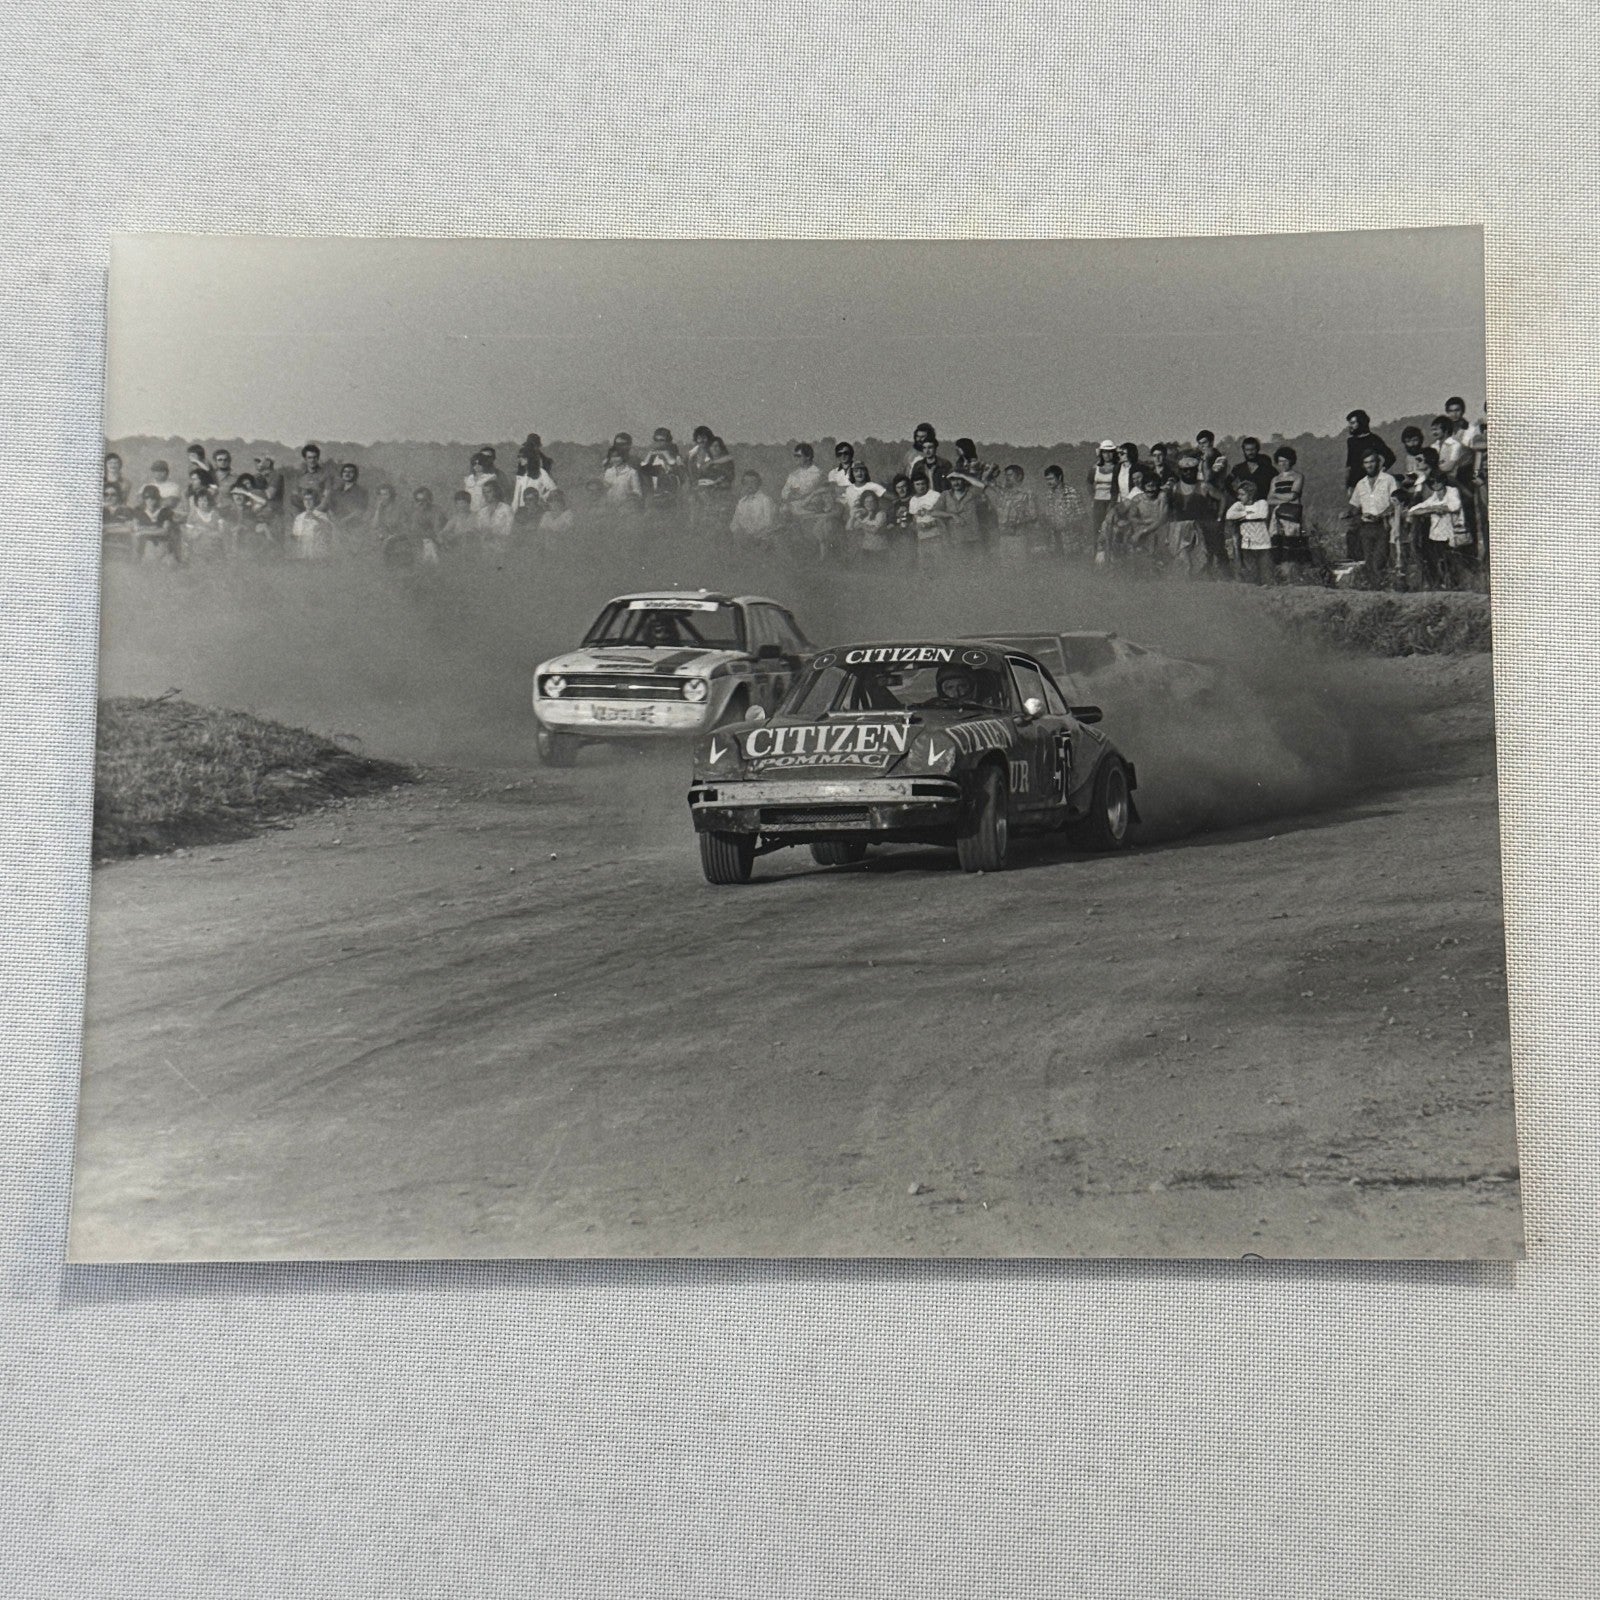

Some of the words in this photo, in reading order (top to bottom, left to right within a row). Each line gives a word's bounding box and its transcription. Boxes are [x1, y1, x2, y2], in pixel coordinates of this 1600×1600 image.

[845, 648, 955, 664] CITIZEN
[746, 724, 910, 757] CITIZEN
[756, 754, 882, 769] POMMAC
[1009, 760, 1030, 793] UR
